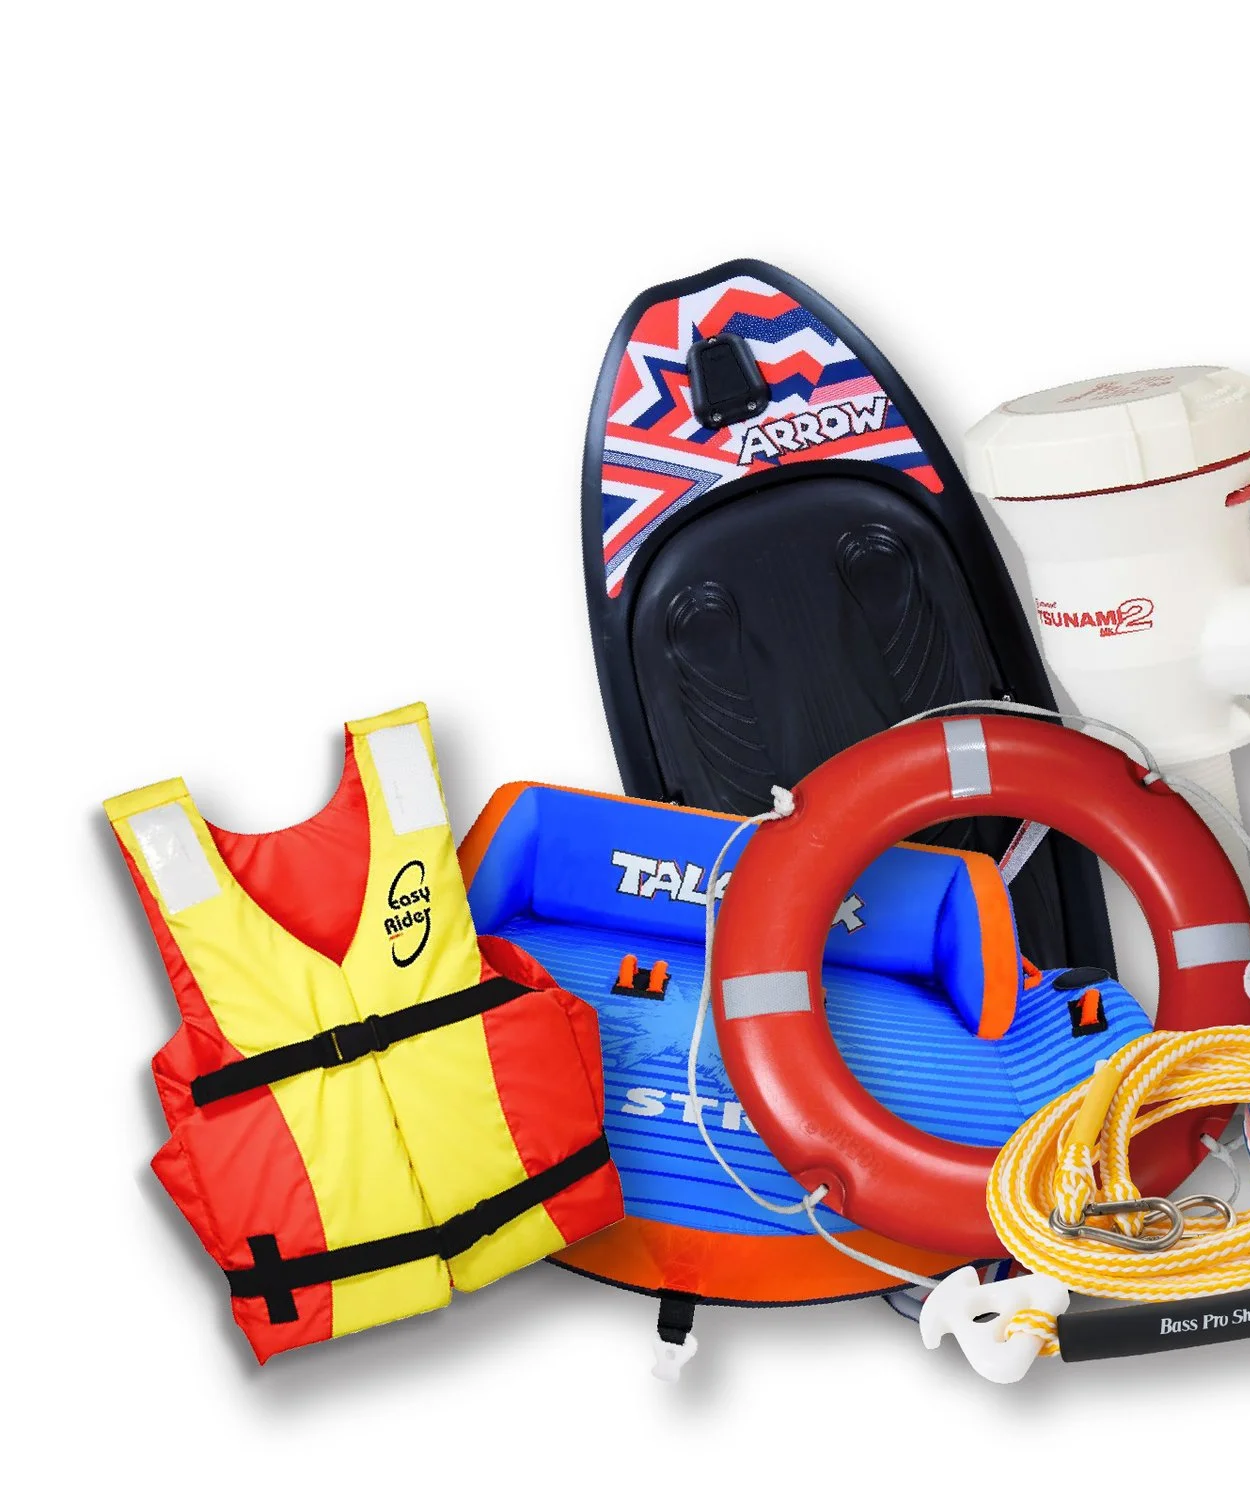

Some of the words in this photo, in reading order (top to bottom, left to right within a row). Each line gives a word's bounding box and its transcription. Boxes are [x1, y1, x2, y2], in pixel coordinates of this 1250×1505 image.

[737, 396, 889, 466] ARROW
[1037, 608, 1124, 628] TSUNAMI
[1116, 598, 1154, 634] 2
[384, 907, 431, 935] Rider
[1160, 1317, 1198, 1335] Bass
[1202, 1313, 1228, 1330] Pro
